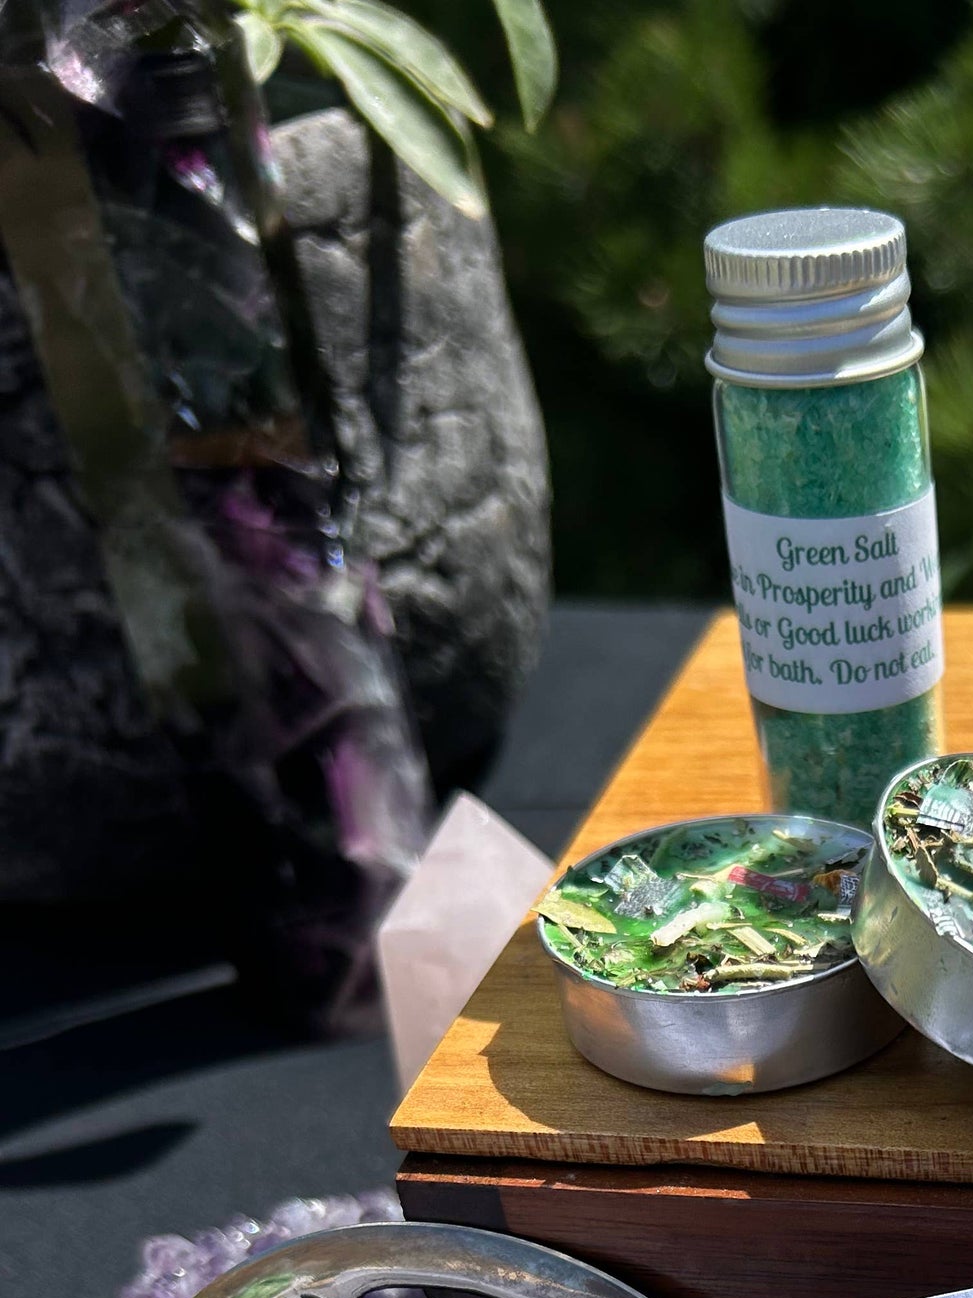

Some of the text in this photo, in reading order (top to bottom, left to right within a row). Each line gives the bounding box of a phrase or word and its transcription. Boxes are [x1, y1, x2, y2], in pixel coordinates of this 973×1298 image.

[777, 532, 898, 571] Green Salt
[757, 573, 875, 613] Prosperity
[881, 566, 916, 599] and
[755, 619, 771, 638] or
[778, 617, 840, 650] Good
[845, 616, 894, 645] luck
[768, 653, 823, 686] bath.
[830, 659, 869, 685] Do
[875, 652, 908, 680] not
